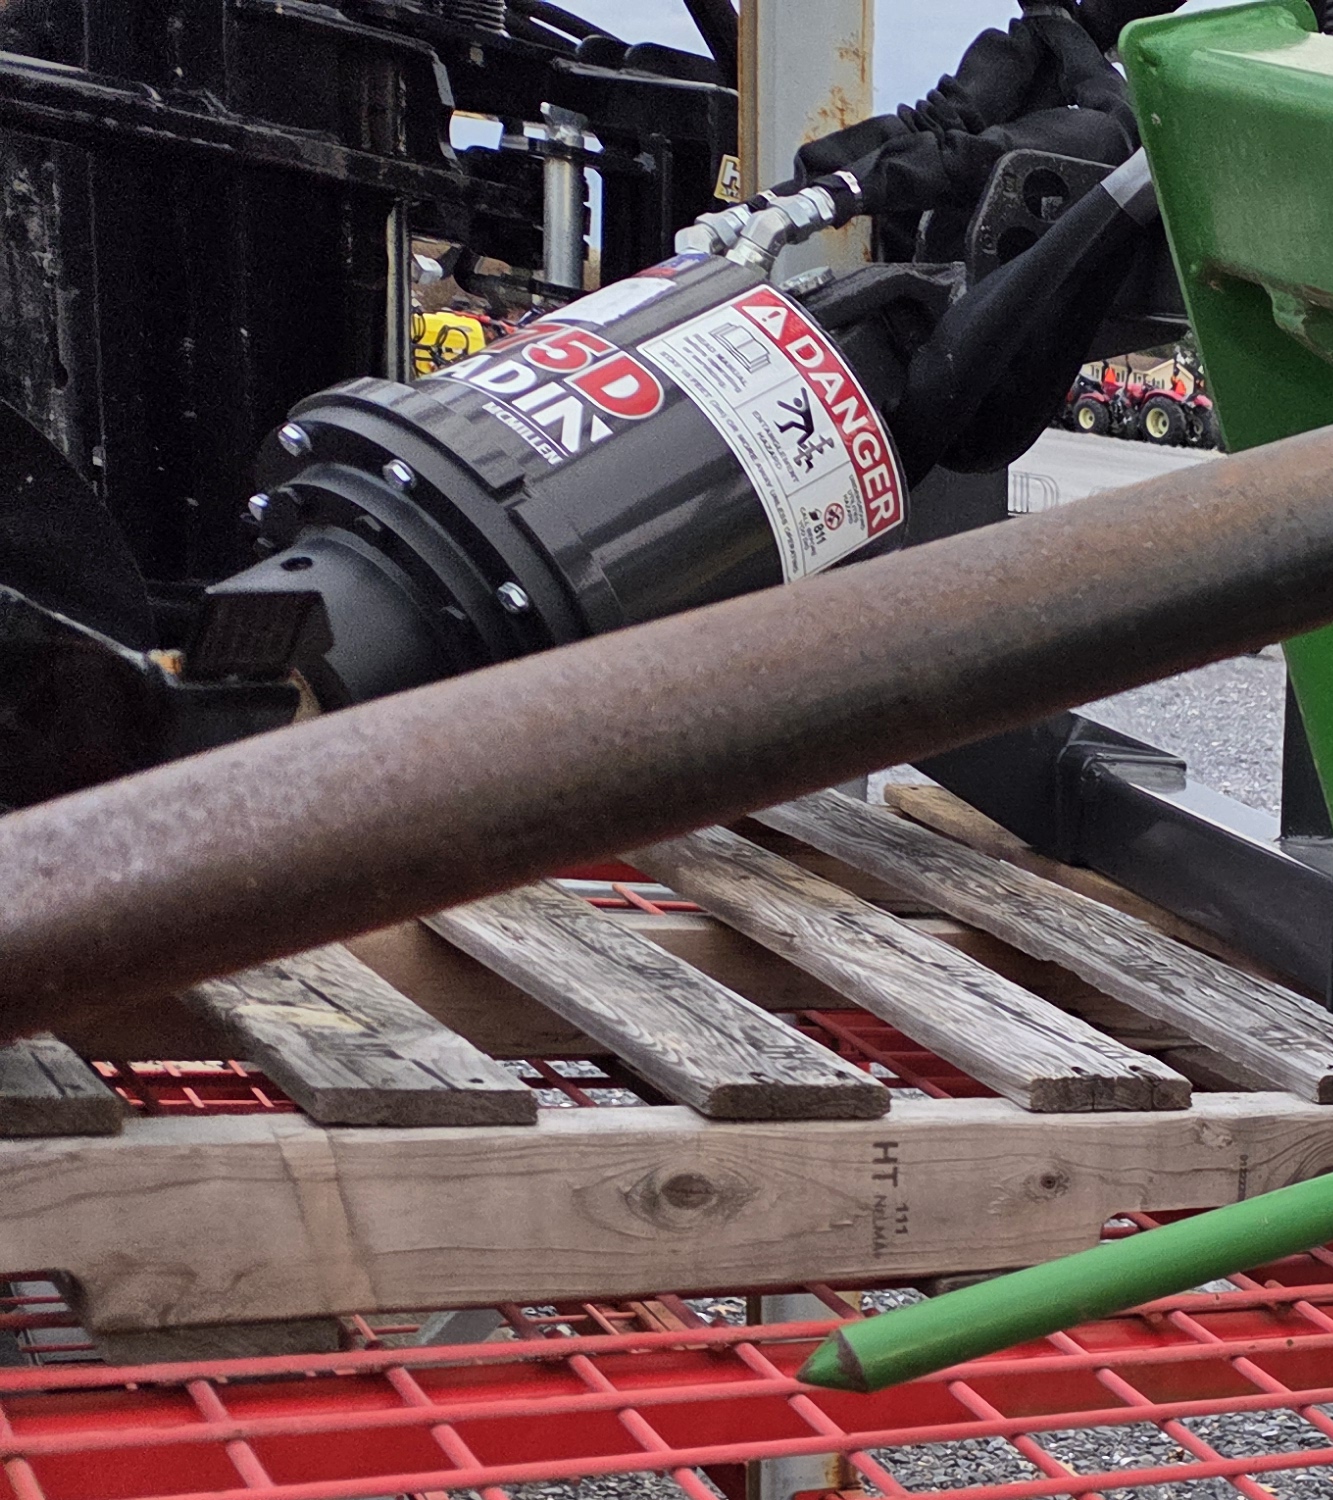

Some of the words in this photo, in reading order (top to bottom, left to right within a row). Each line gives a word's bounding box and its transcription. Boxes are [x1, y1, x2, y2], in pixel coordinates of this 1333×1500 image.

[786, 335, 895, 529] DANGER
[813, 524, 827, 545] 811
[872, 1141, 899, 1188] HT
[895, 1202, 909, 1234] 111
